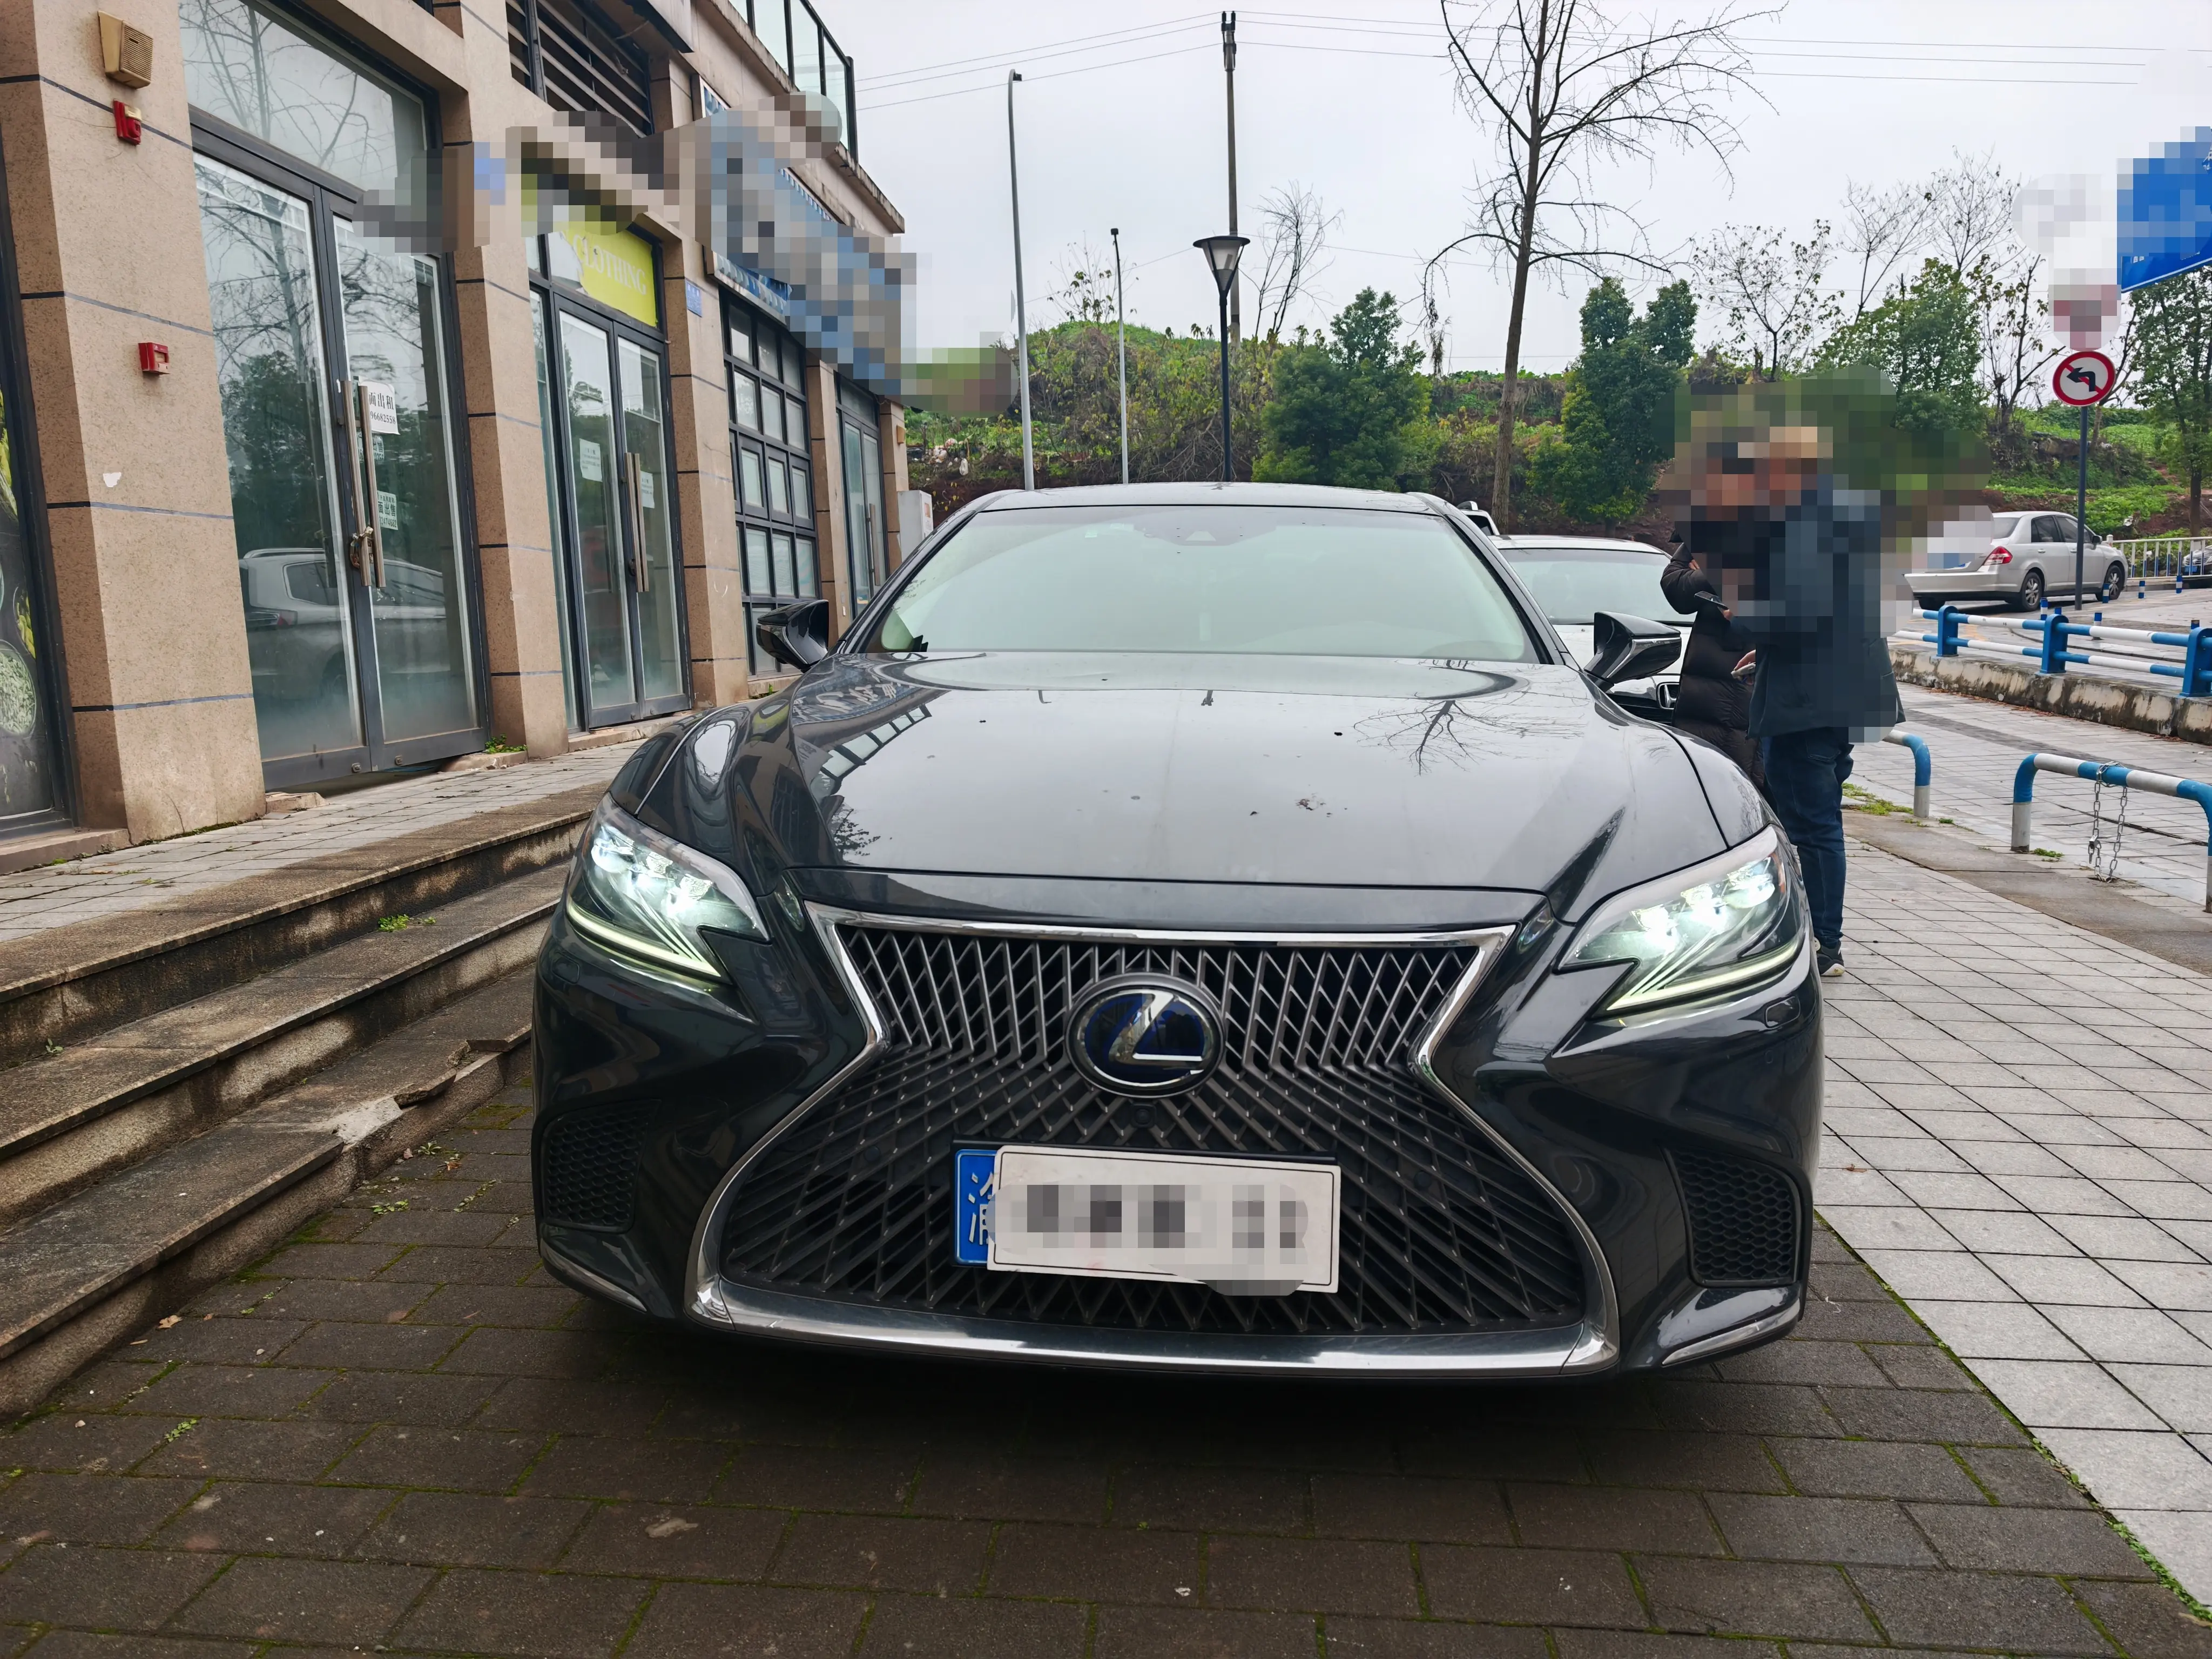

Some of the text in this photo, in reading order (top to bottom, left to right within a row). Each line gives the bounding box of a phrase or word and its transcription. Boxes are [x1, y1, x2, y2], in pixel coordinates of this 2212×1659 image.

[573, 234, 647, 295] CLOTHING
[369, 392, 395, 409] 面出租
[370, 411, 396, 424] 96682558
[378, 501, 396, 516] 面出售
